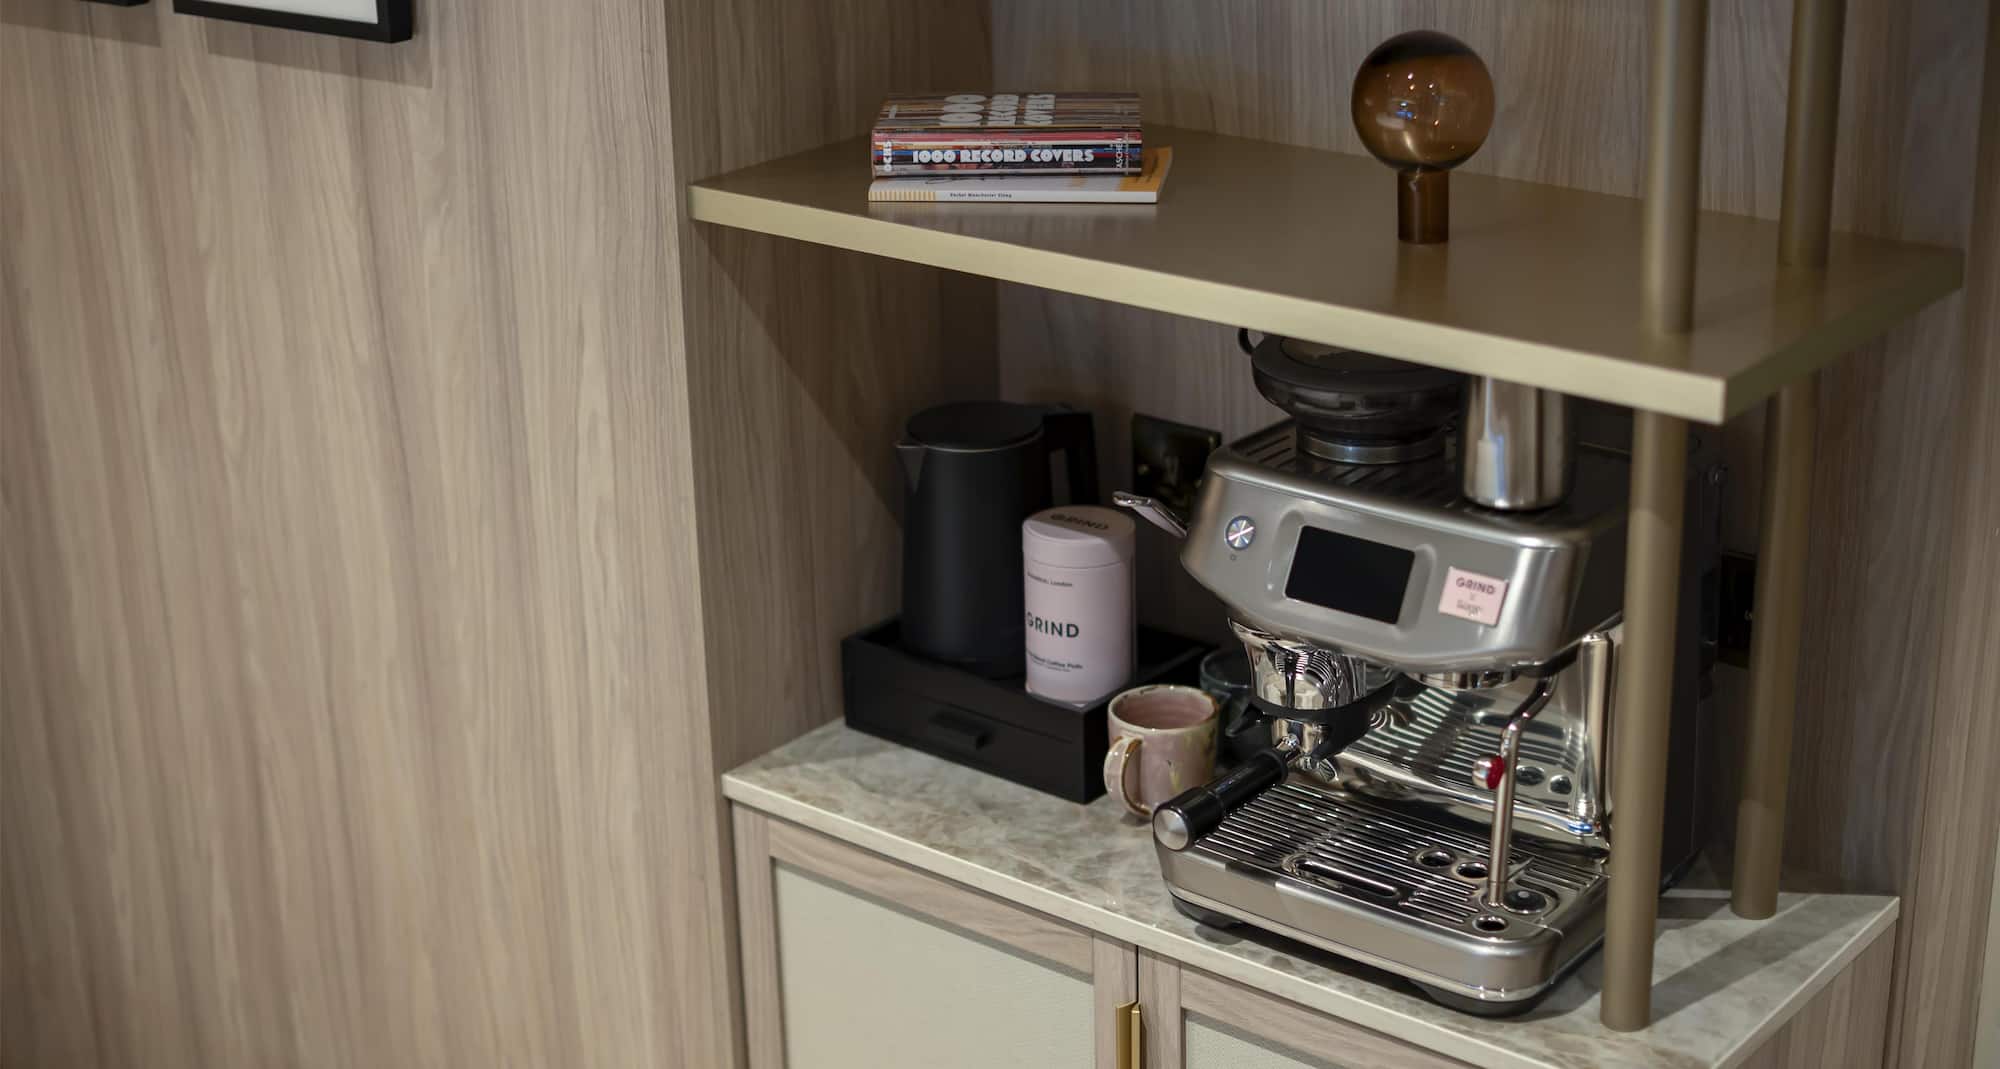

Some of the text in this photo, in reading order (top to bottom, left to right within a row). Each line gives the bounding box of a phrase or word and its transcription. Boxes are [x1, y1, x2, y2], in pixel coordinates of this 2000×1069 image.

[912, 148, 1095, 164] 1000 RECORD COVERS
[1050, 513, 1109, 530] GRIND
[1456, 577, 1496, 595] GRIND
[1027, 611, 1080, 638] GRIND
